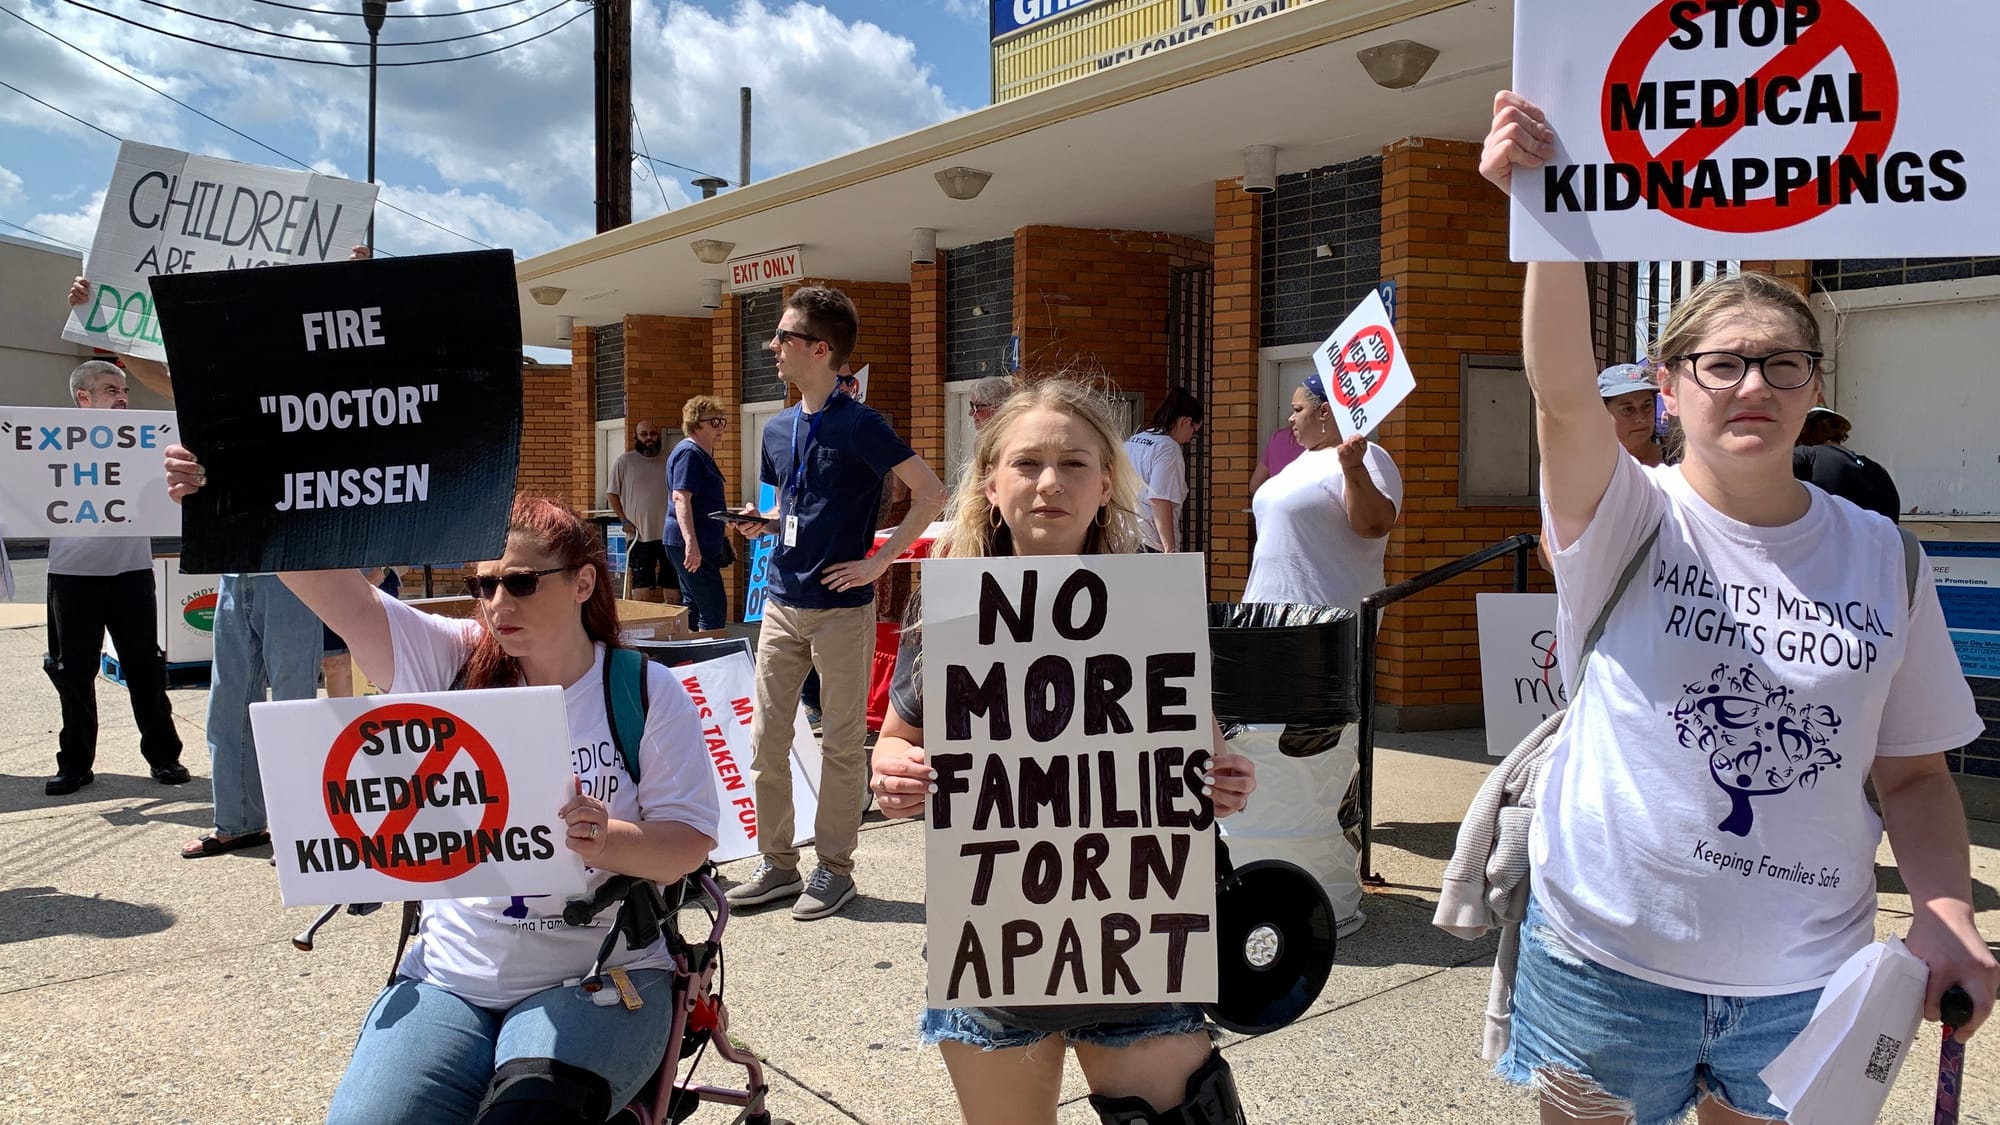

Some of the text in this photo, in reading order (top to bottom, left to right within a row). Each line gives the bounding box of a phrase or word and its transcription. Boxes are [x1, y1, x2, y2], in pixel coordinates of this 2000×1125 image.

[1668, 0, 1821, 51] STOP
[1610, 72, 1881, 132] MEDICAL
[1544, 149, 1967, 213] KIDNAPPINGS
[129, 171, 343, 261] CHILDREN
[134, 245, 196, 274] ARE
[733, 255, 795, 284] EXIT ONLY
[1382, 286, 1393, 320] 3
[302, 307, 386, 351] FIRE
[1368, 331, 1390, 366] STOP
[1326, 341, 1367, 431] KIDNAPPINGS
[1347, 335, 1378, 396] MEDICAL
[259, 384, 439, 433] "DOCTOR"
[1, 421, 172, 451] "EXPOSE"
[48, 462, 121, 487] THE
[275, 464, 430, 511] JENSSEN
[46, 499, 132, 524] C.A.C.
[180, 587, 215, 606] CANDY
[978, 568, 1108, 646] NO
[1653, 560, 1893, 637] PARENTS' MEDICAL
[1665, 605, 1877, 673] RIGHTS GROUP
[945, 652, 1197, 743] MORE
[359, 717, 457, 756] STOP
[681, 675, 713, 719] WAS
[703, 724, 746, 791] TAKEN
[327, 770, 499, 815] MEDICAL
[931, 748, 1215, 832] FAMILIES
[296, 825, 555, 874] KIDNAPPINGS
[959, 833, 1191, 905] TORN
[1693, 840, 1841, 888] Keeping Families Safe
[947, 913, 1210, 1001] APART
